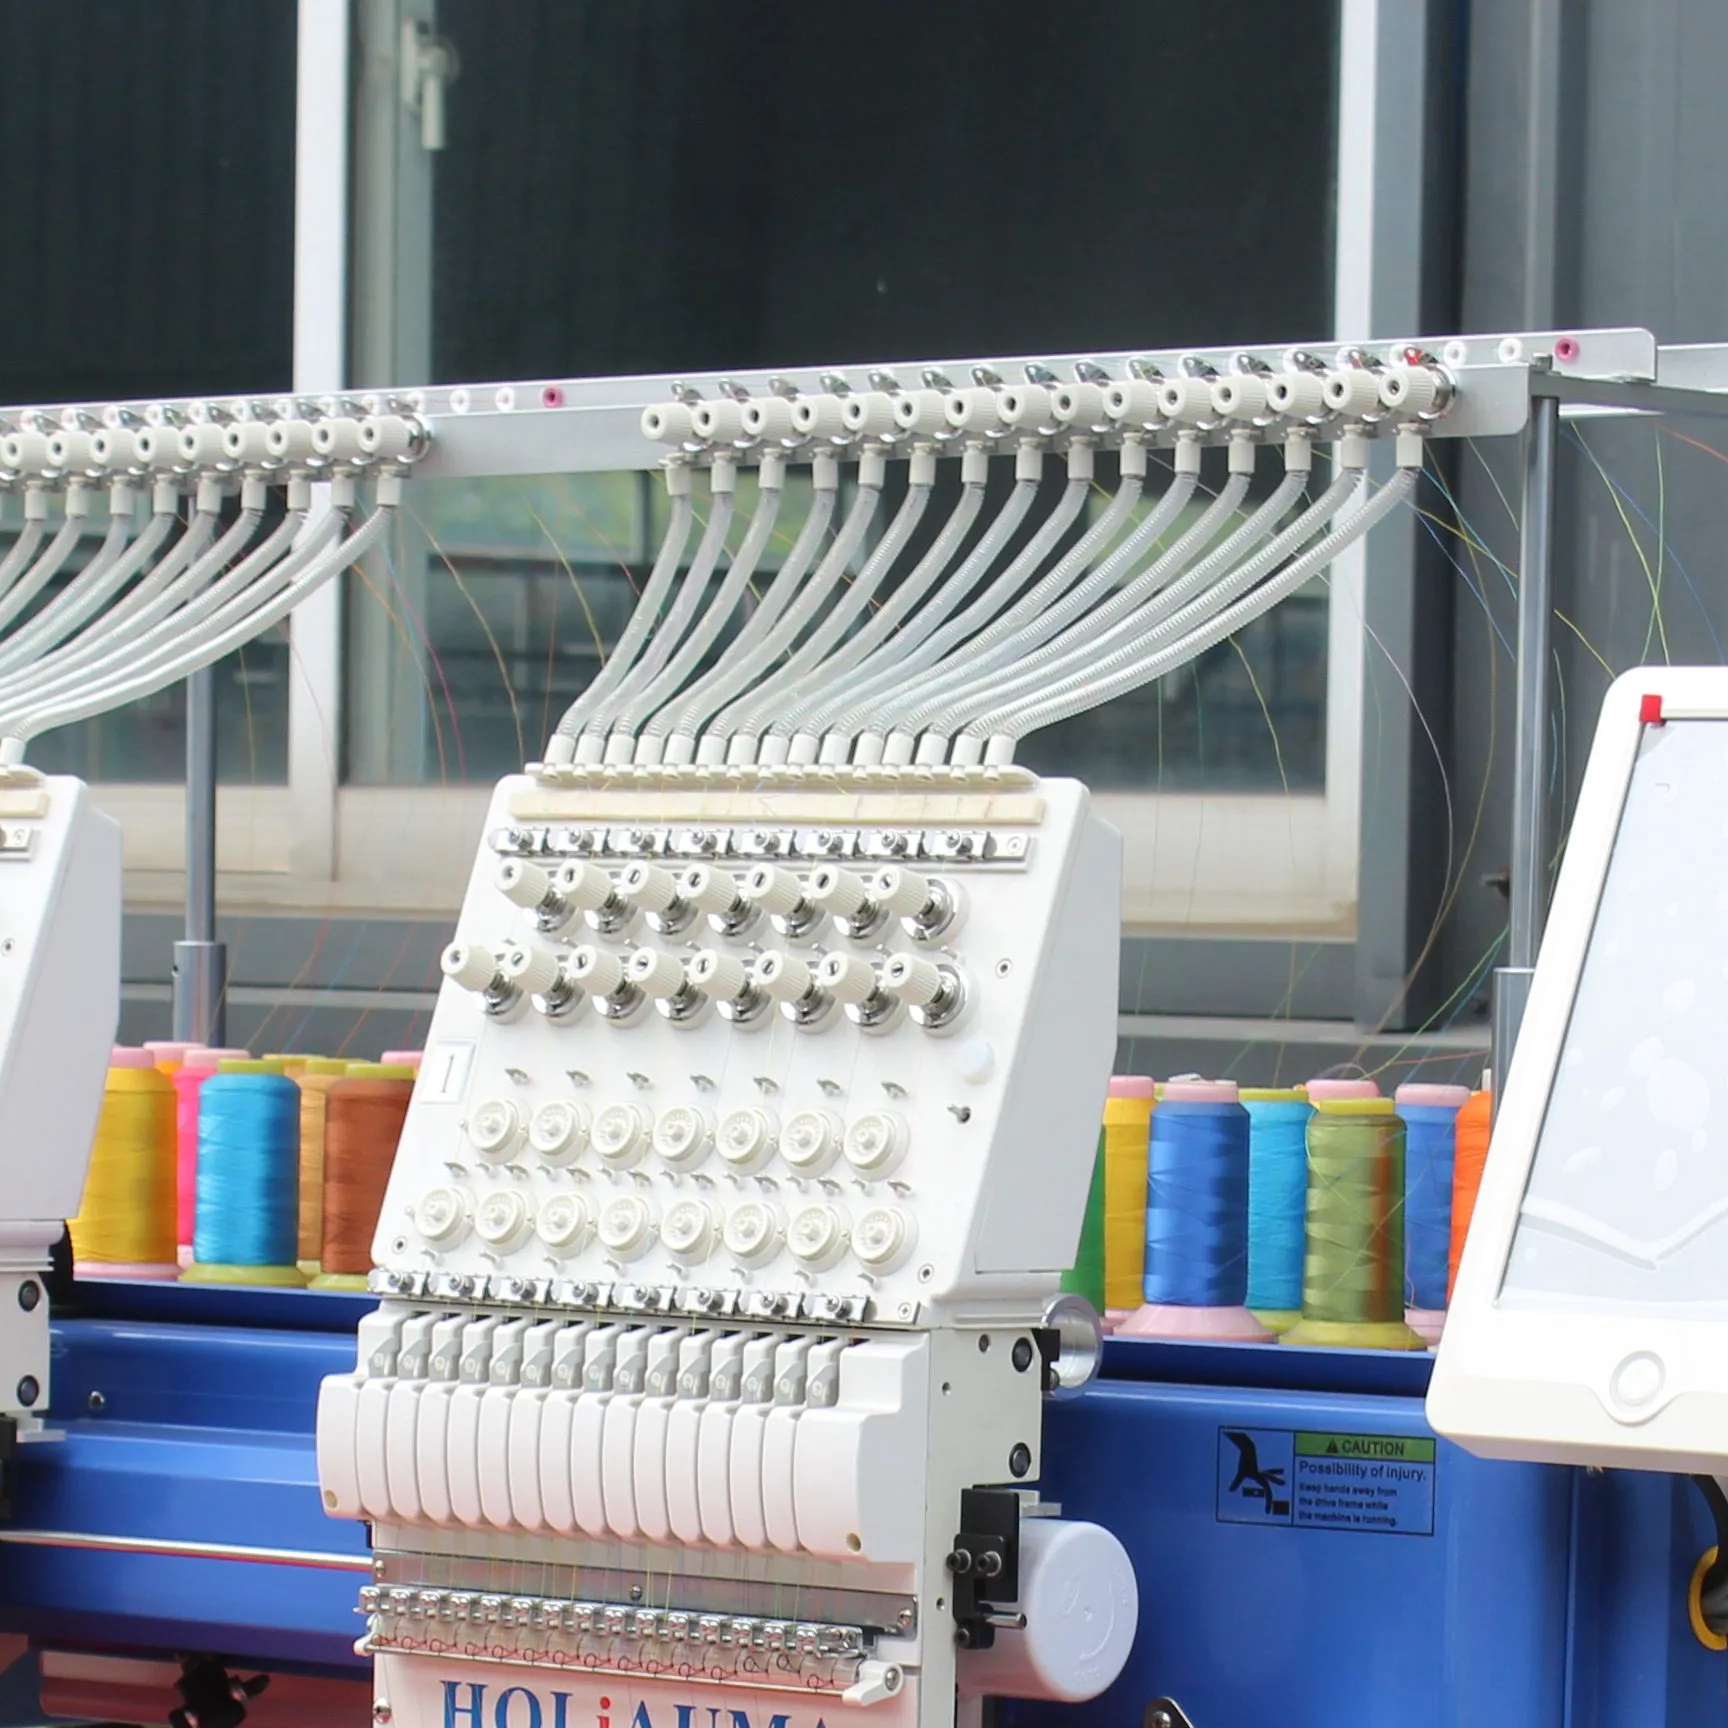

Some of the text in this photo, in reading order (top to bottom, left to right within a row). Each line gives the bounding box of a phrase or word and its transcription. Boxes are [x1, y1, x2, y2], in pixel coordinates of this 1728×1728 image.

[440, 1053, 456, 1094] 1
[1342, 1440, 1404, 1456] CAUTION
[1300, 1460, 1427, 1482] Possibility of injury.
